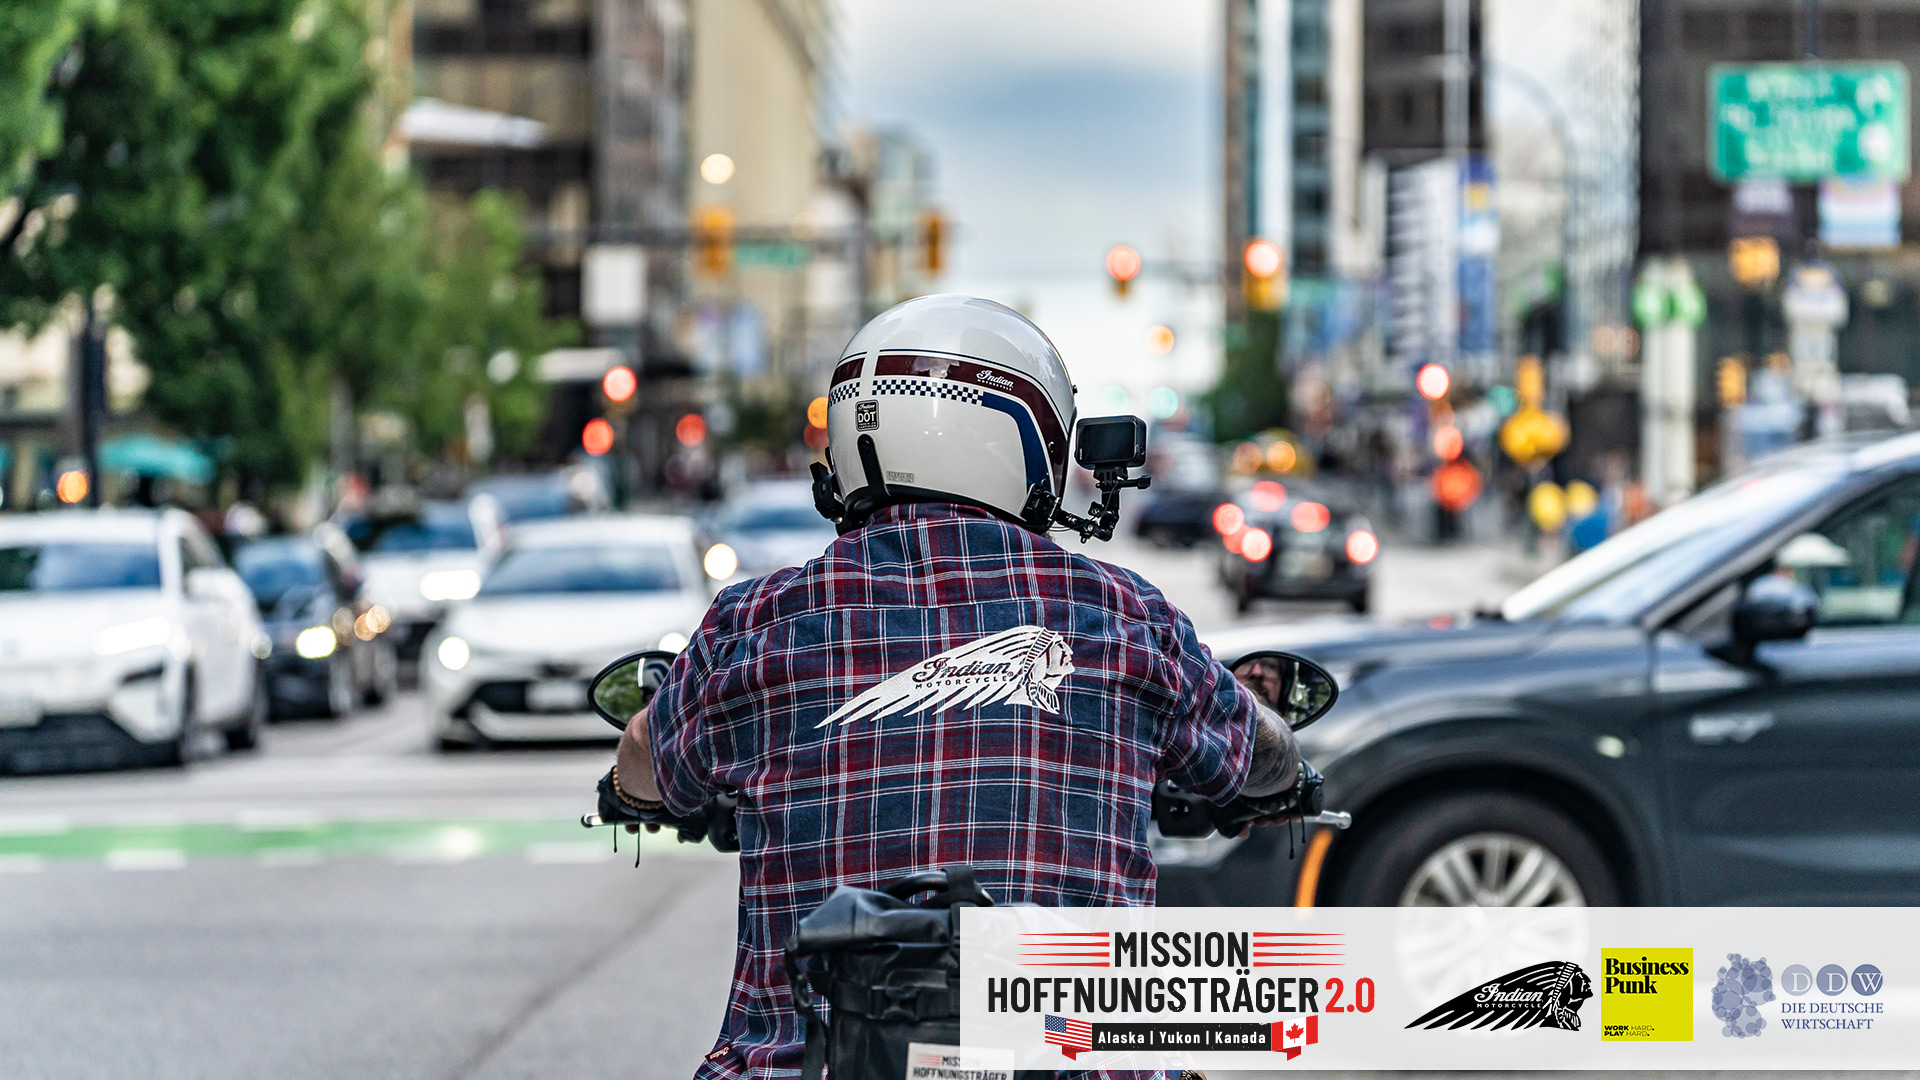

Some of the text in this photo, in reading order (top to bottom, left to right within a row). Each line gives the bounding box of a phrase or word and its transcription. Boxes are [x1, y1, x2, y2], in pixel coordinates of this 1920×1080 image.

[976, 370, 1013, 388] Indian
[858, 412, 876, 423] DOT
[912, 657, 1011, 683] Indian
[915, 676, 1007, 689] MOTORCYCLE
